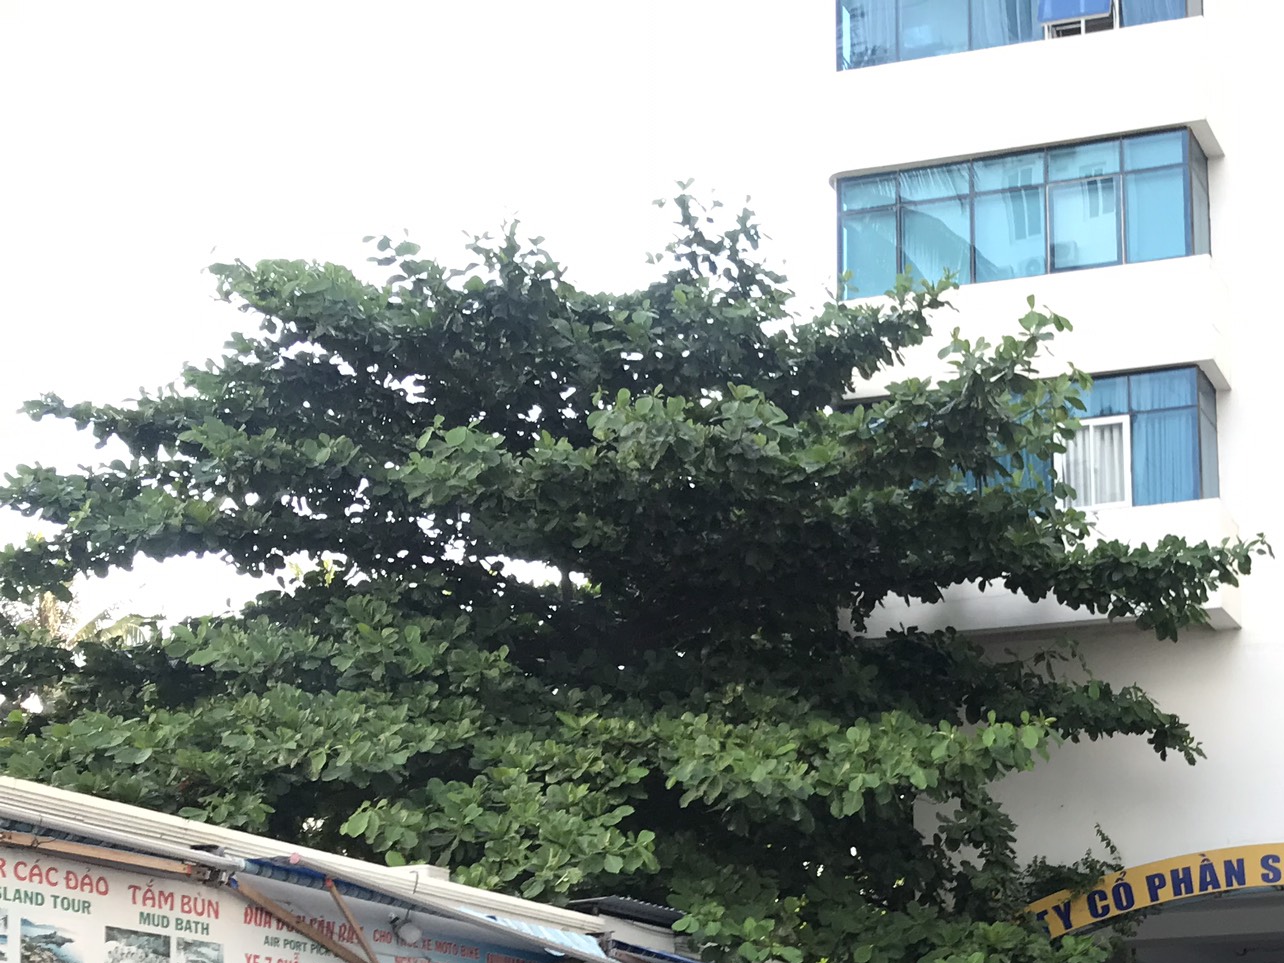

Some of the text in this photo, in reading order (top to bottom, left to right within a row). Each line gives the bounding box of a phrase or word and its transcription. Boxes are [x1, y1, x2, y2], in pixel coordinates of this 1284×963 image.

[13, 859, 58, 887] CÁC
[63, 866, 109, 896] ĐẢO
[1086, 871, 1135, 919] CỔ
[1145, 853, 1247, 902] PHẦN
[50, 894, 91, 915] TOUR
[139, 911, 170, 929] MUD
[174, 917, 209, 936] BATH
[263, 936, 280, 948] AIR
[283, 938, 308, 953] PORT
